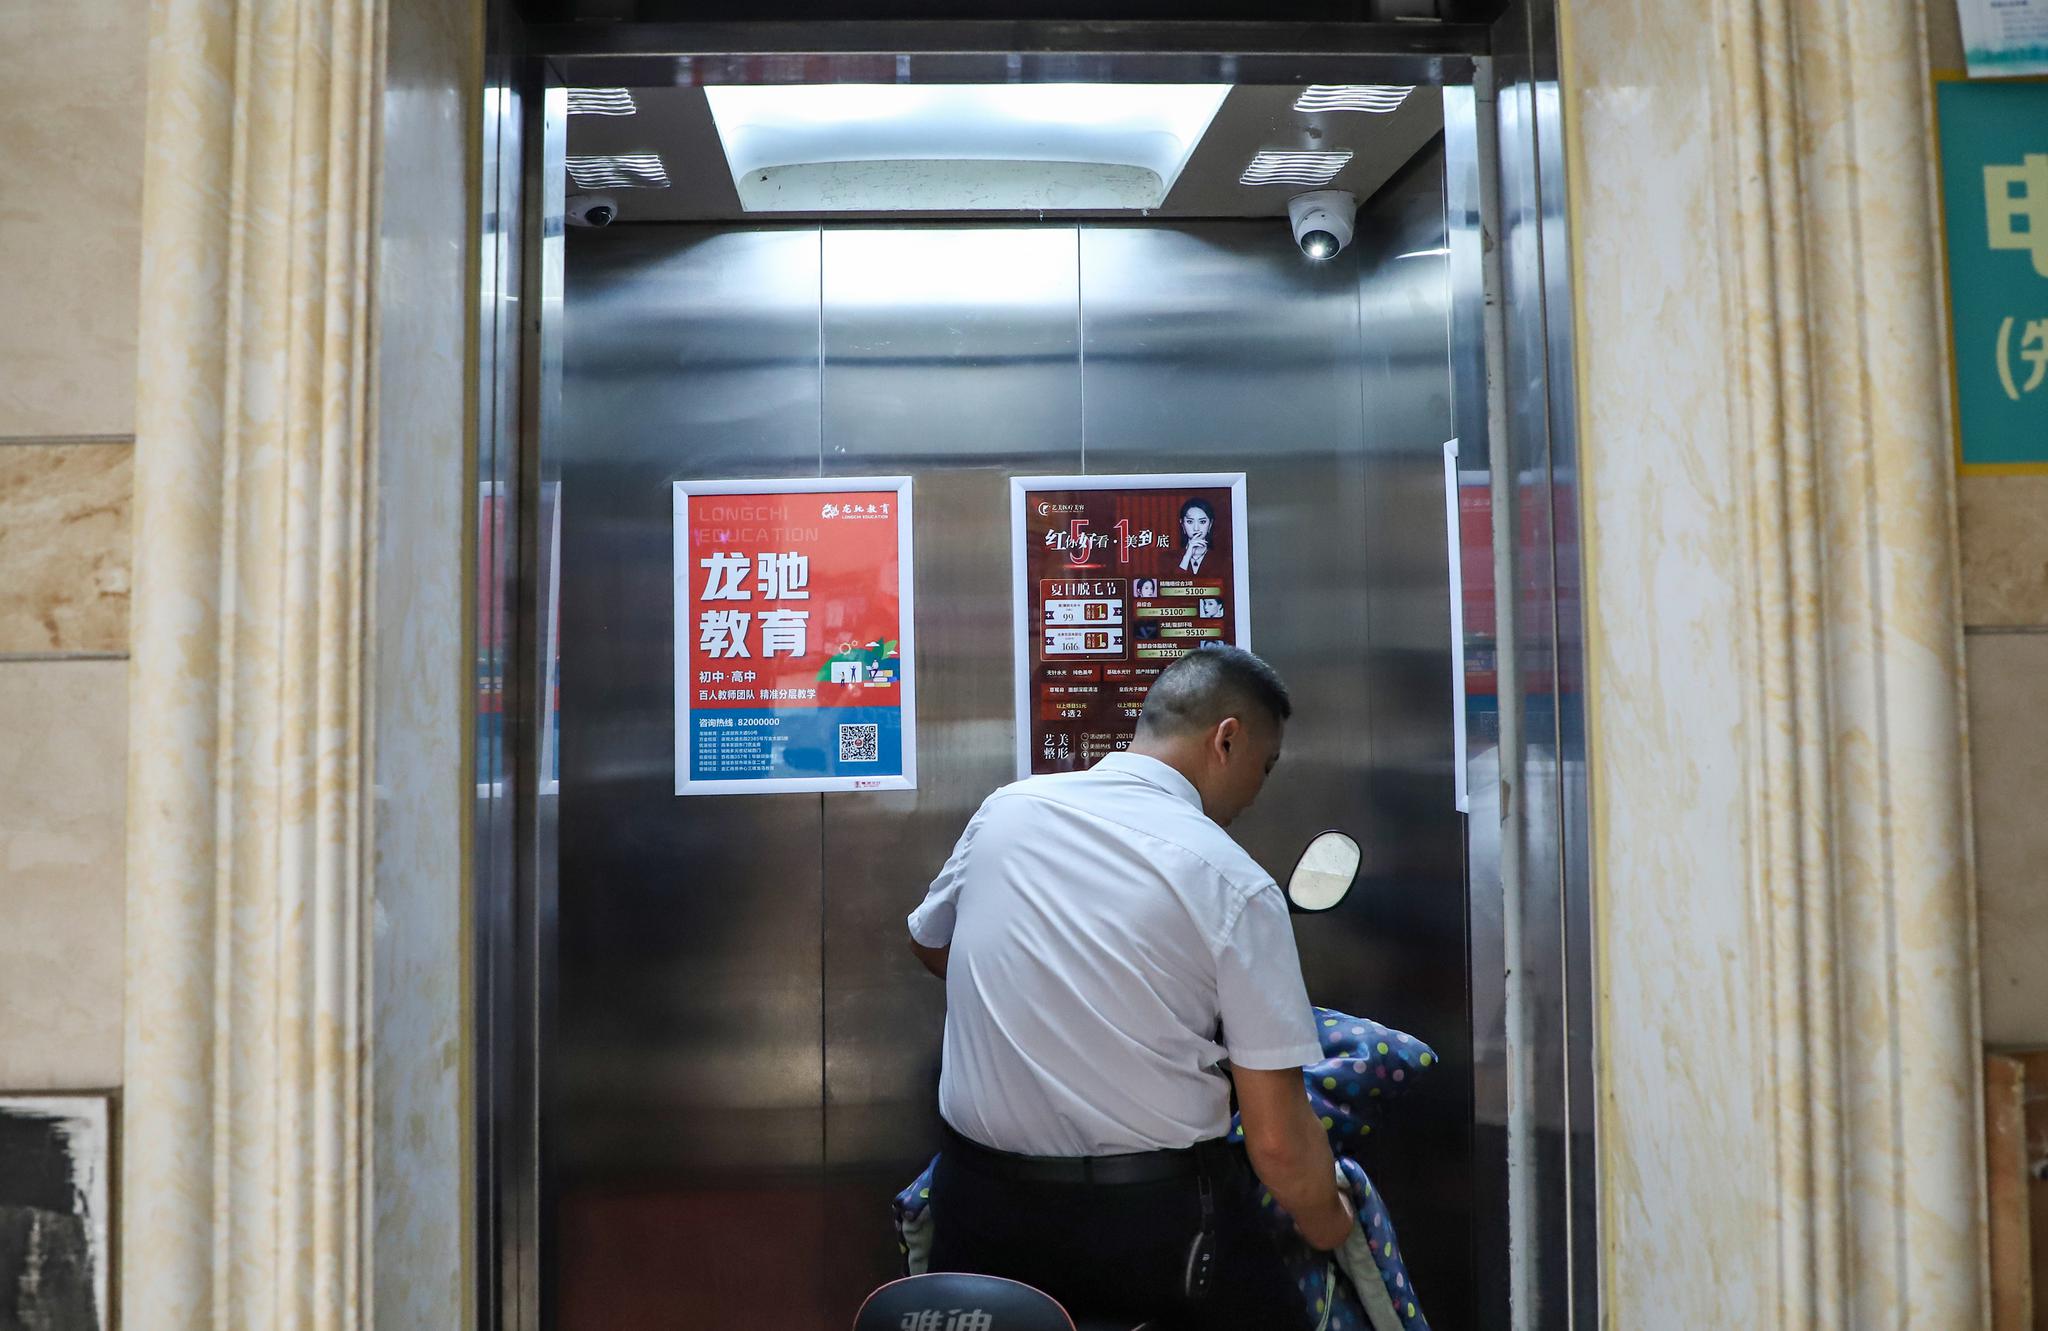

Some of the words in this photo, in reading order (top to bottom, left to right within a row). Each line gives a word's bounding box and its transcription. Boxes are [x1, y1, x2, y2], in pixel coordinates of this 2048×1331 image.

[699, 506, 789, 521] LONGCHI
[699, 527, 819, 543] EDUCATION
[700, 551, 810, 601] 龙驰
[1051, 582, 1117, 596] 夏日脱毛节
[1062, 613, 1074, 621] 99
[700, 609, 810, 659] 教育
[1062, 642, 1079, 651] 1616
[699, 670, 757, 684] 初中·高中
[699, 690, 755, 701] 百人教师团队
[760, 688, 817, 700] 精准分层教学
[737, 717, 780, 726] 82000000
